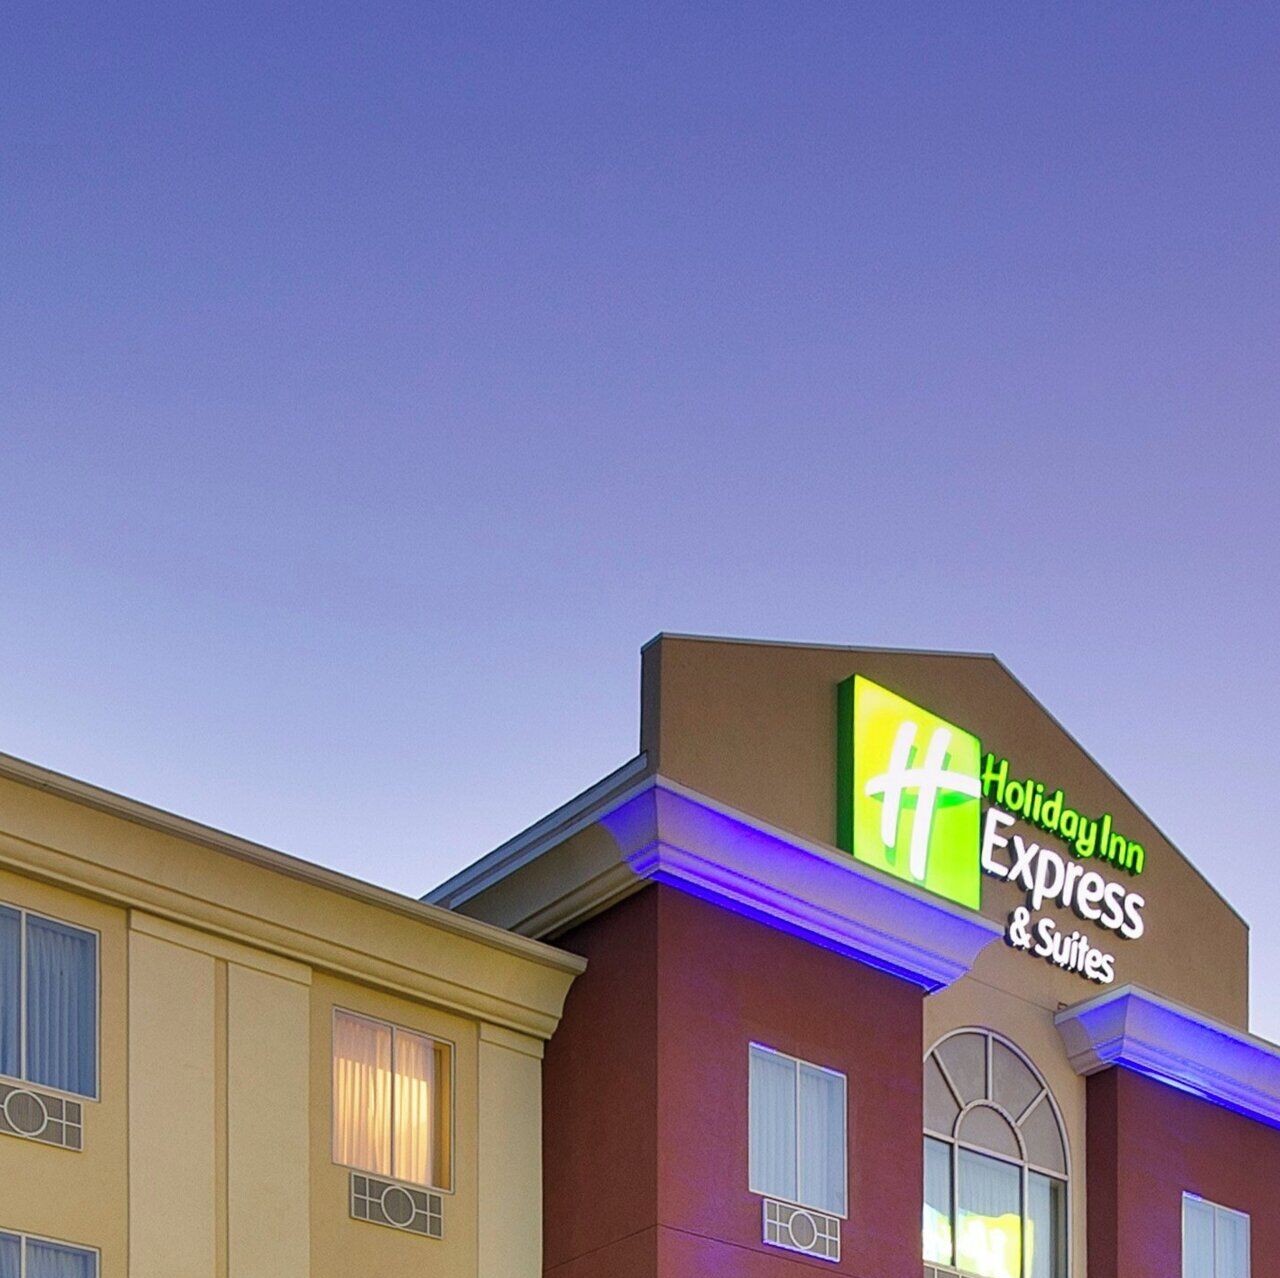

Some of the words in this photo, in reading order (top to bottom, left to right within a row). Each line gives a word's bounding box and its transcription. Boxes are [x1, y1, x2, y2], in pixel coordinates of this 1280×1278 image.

[981, 753, 1097, 858] Holiday
[1099, 814, 1145, 874] Inn
[981, 807, 1146, 940] Express
[1009, 907, 1032, 949] &
[1034, 917, 1115, 984] Suites
